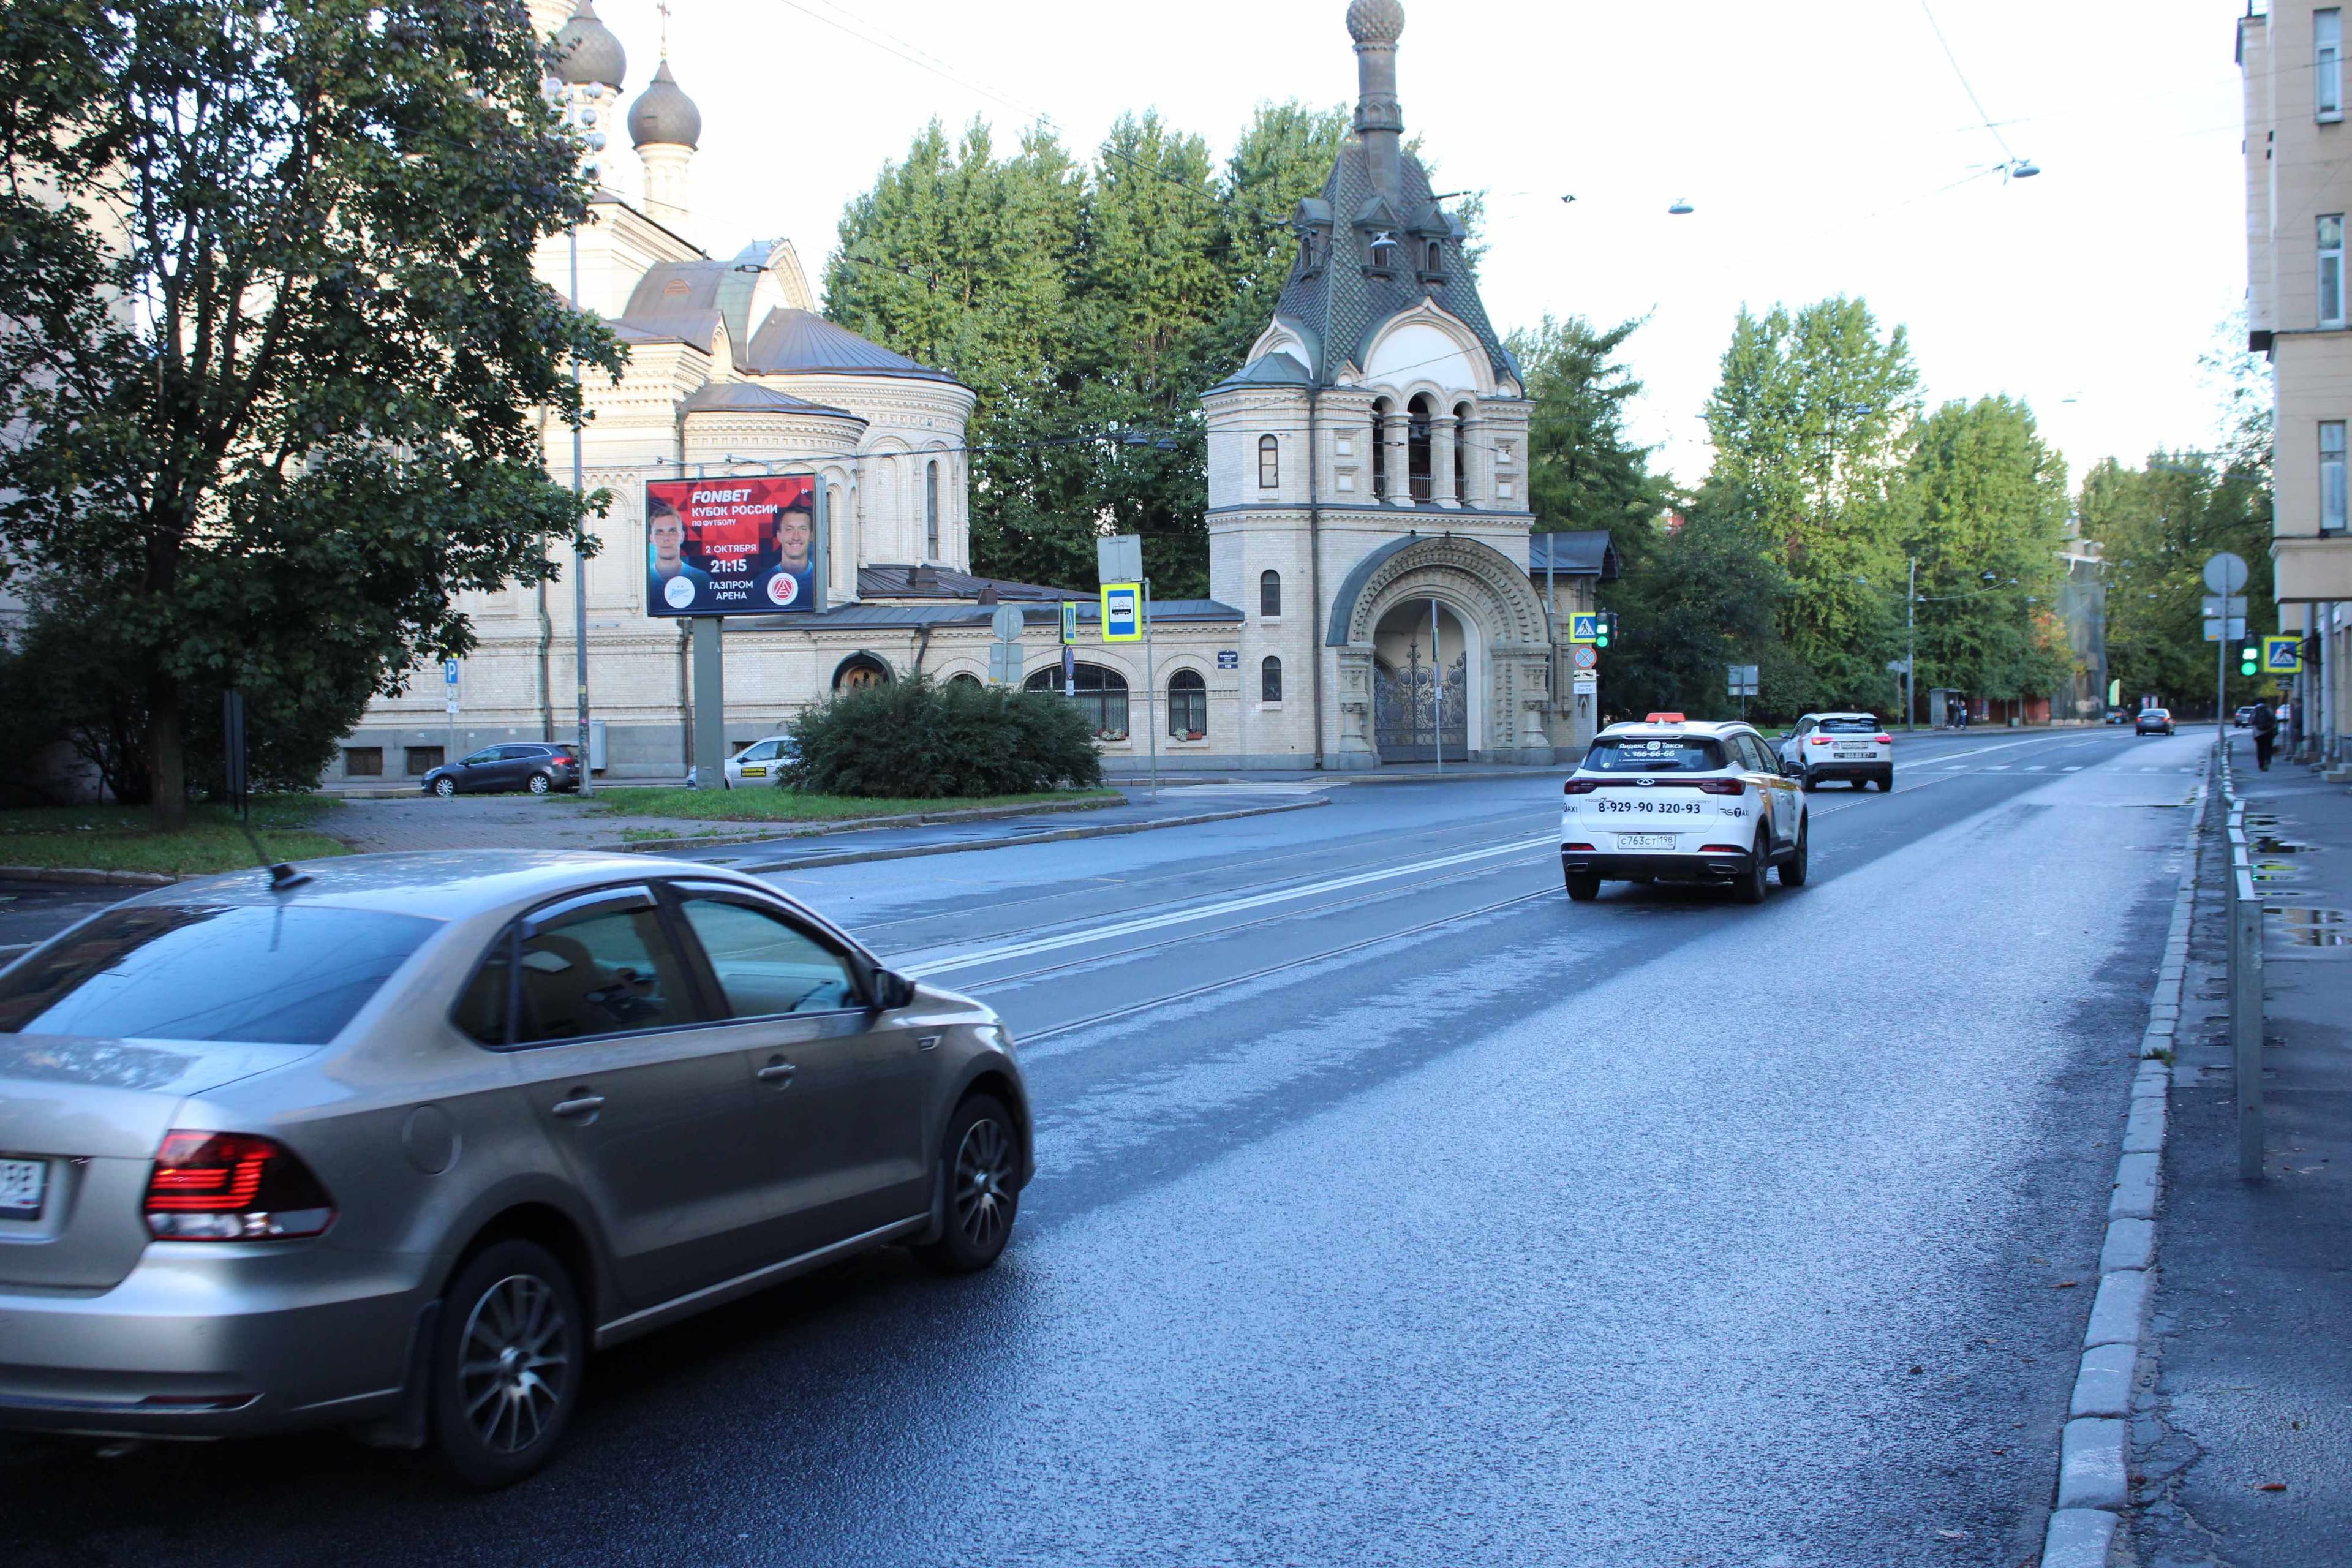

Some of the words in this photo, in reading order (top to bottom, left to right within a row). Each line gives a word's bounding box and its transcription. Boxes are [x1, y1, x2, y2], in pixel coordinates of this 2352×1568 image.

[692, 489, 752, 503] FONBET
[692, 507, 728, 517] КУБОК
[731, 504, 778, 515] РОССИИ
[714, 544, 756, 553] ОКТЯБРЯ
[710, 559, 747, 573] 21:15
[709, 580, 753, 589] ГАЗПРОМ
[716, 591, 747, 600] АРЕНА
[1658, 803, 1700, 814] 320-93
